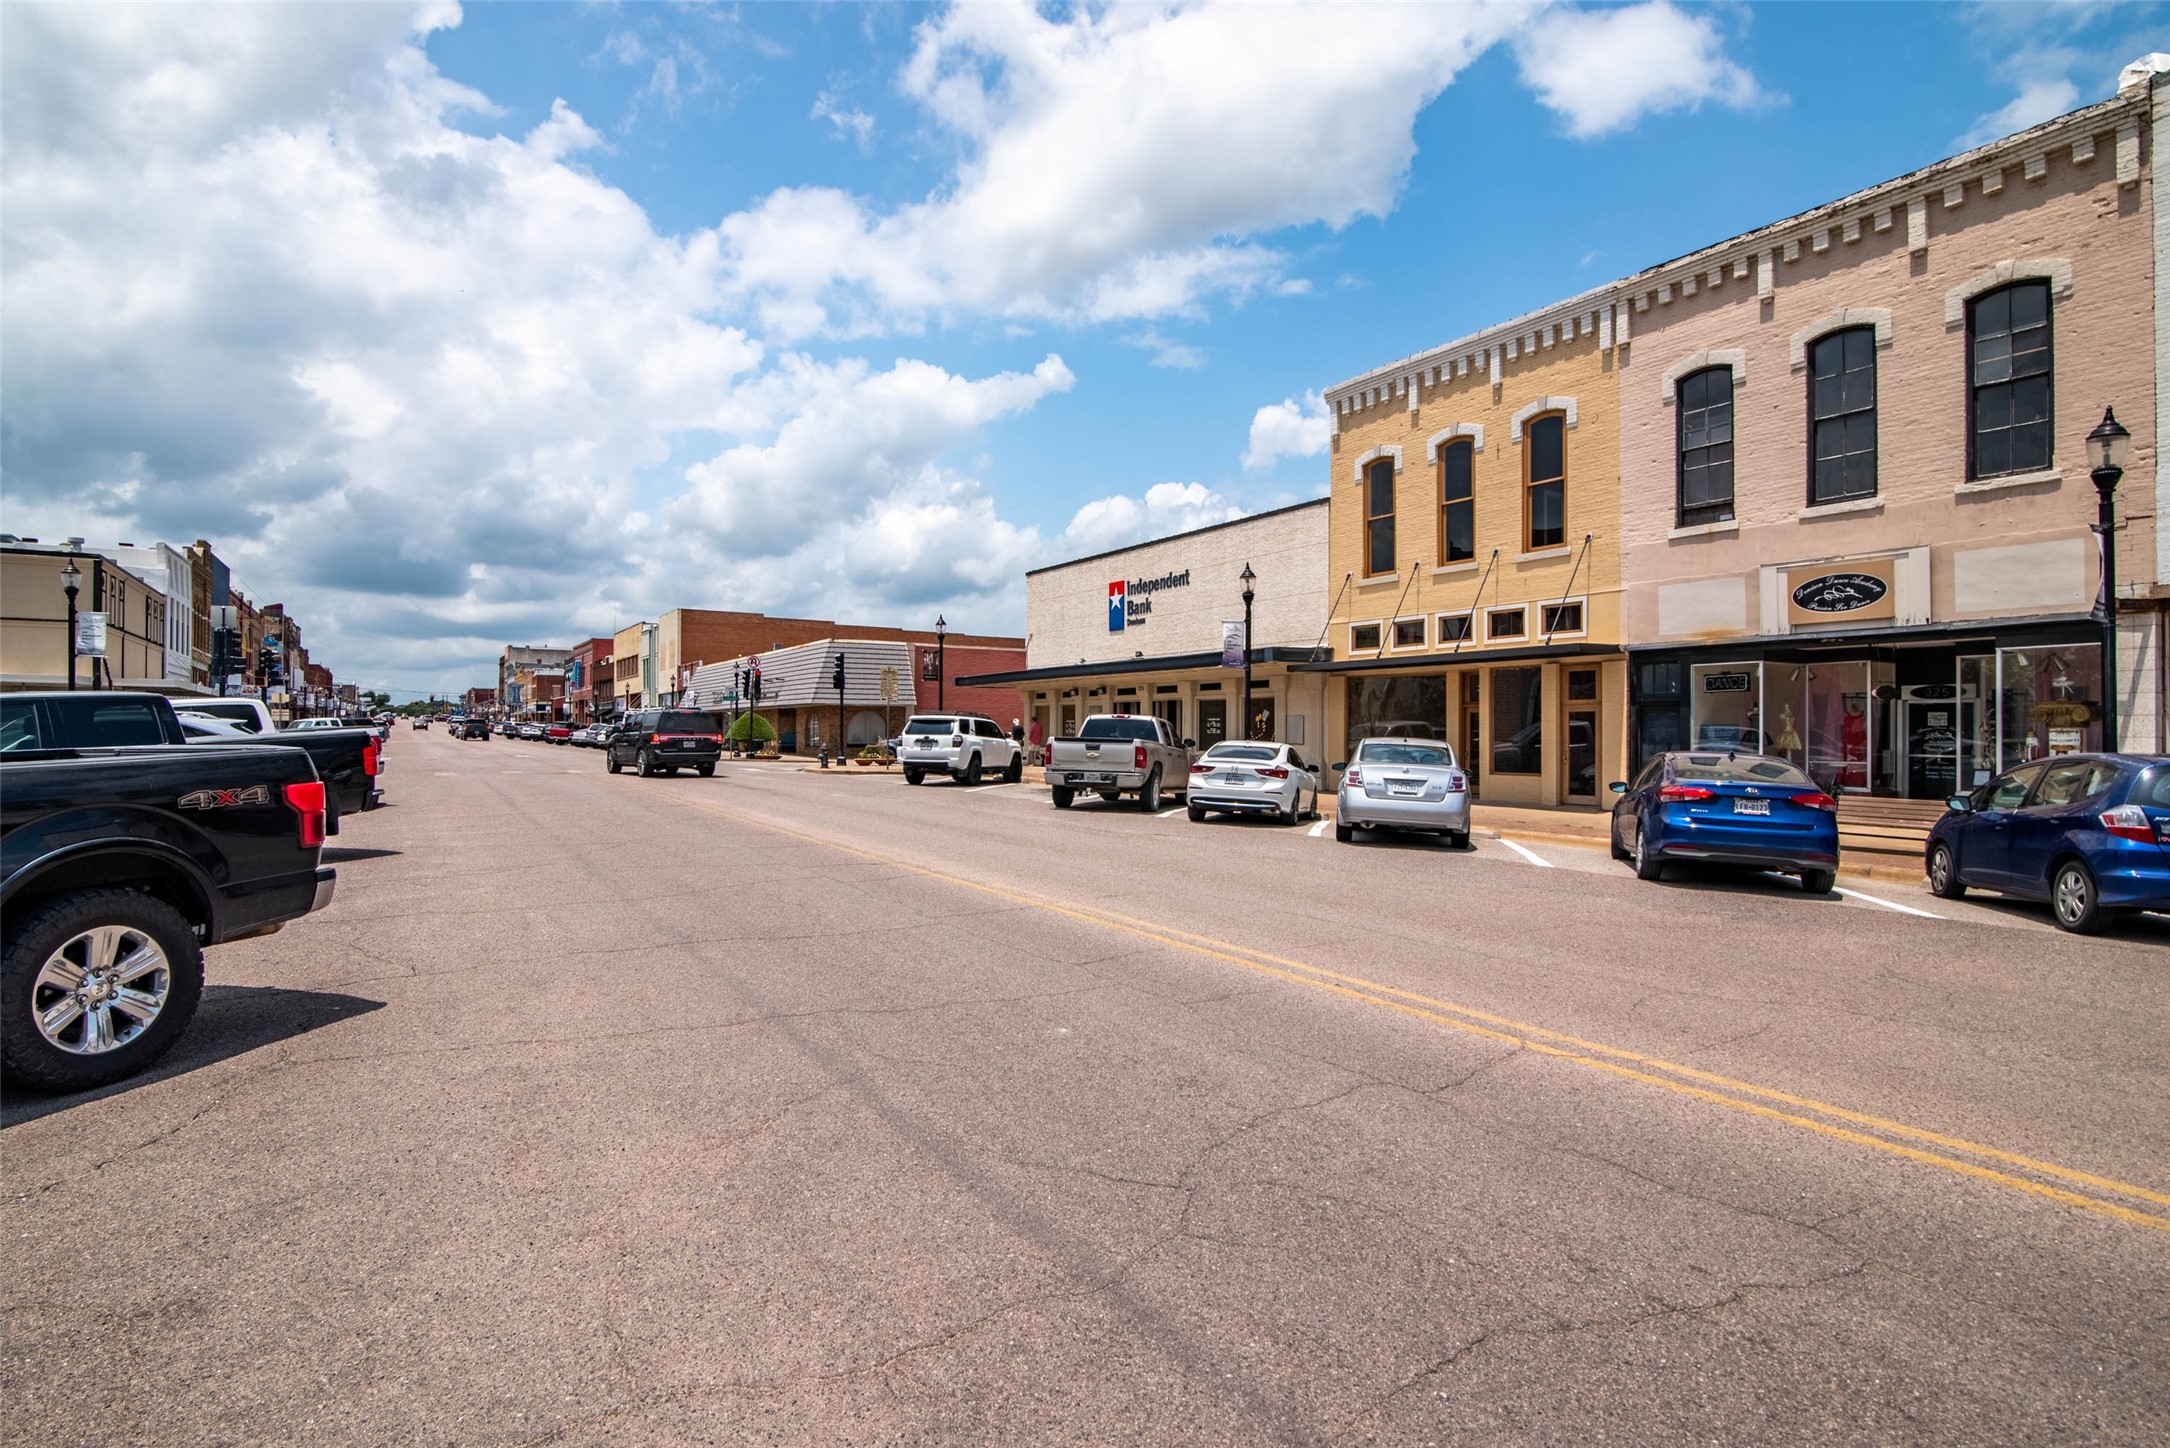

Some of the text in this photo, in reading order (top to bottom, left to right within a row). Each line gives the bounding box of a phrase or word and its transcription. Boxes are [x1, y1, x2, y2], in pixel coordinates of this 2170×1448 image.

[1127, 569, 1190, 597] Independent
[1796, 576, 1882, 599] Denison Dance Academy
[1127, 597, 1152, 616] Bank
[1807, 600, 1871, 611] Passion For Dance
[1706, 677, 1745, 690] DANCE
[1926, 688, 1949, 697] 325
